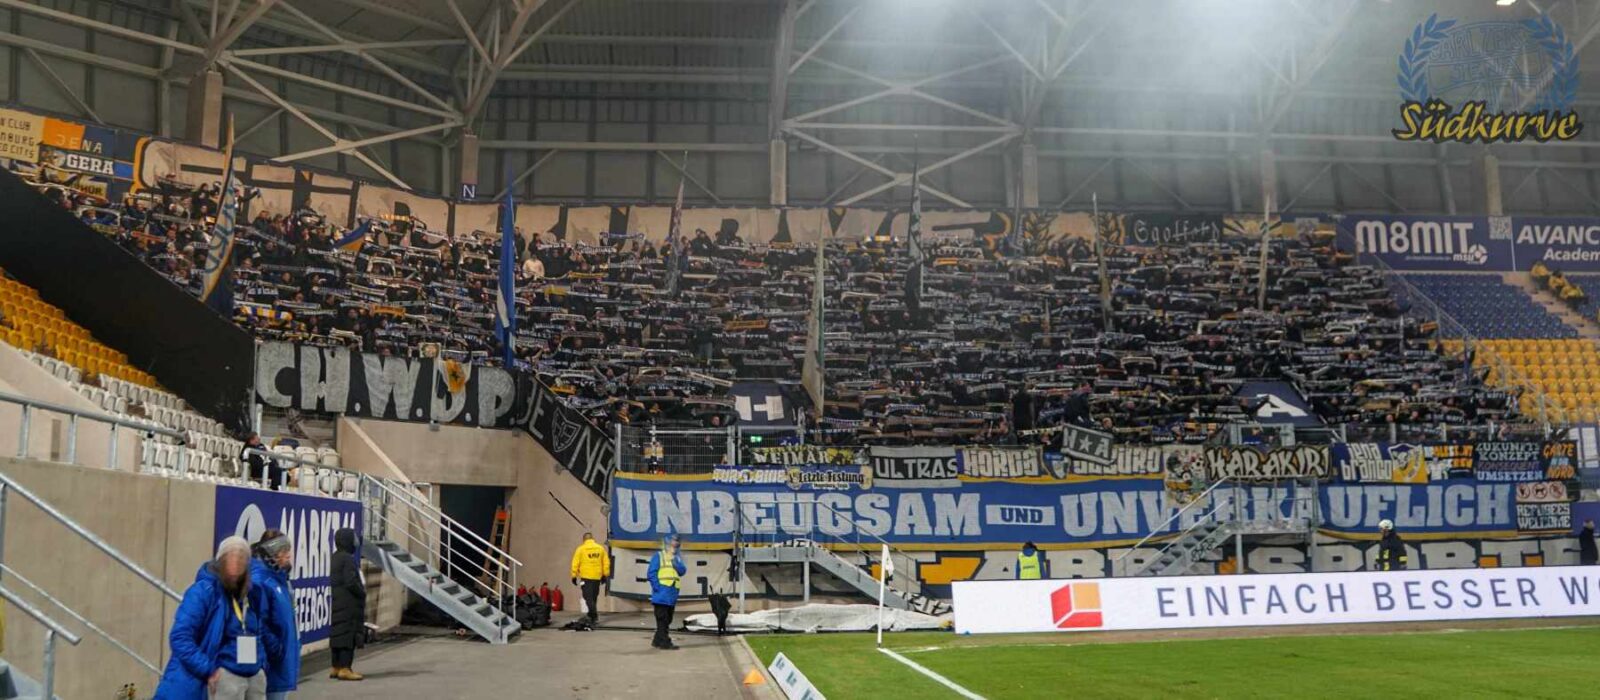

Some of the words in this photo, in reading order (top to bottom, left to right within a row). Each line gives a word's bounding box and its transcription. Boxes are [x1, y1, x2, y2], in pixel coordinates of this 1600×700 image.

[66, 153, 114, 175] GERA
[463, 184, 476, 199] N
[1355, 220, 1474, 255] M8MIT
[1204, 446, 1329, 480] HARAKIRI
[1479, 451, 1539, 461] KONZEPT
[874, 457, 957, 479] ULTRAS
[1477, 471, 1543, 480] UMSETZEN
[616, 486, 982, 535] UNBEUGSAM
[1000, 506, 1044, 524] UND
[1155, 582, 1350, 619] EINFACH
[1372, 577, 1542, 613] BESSER
